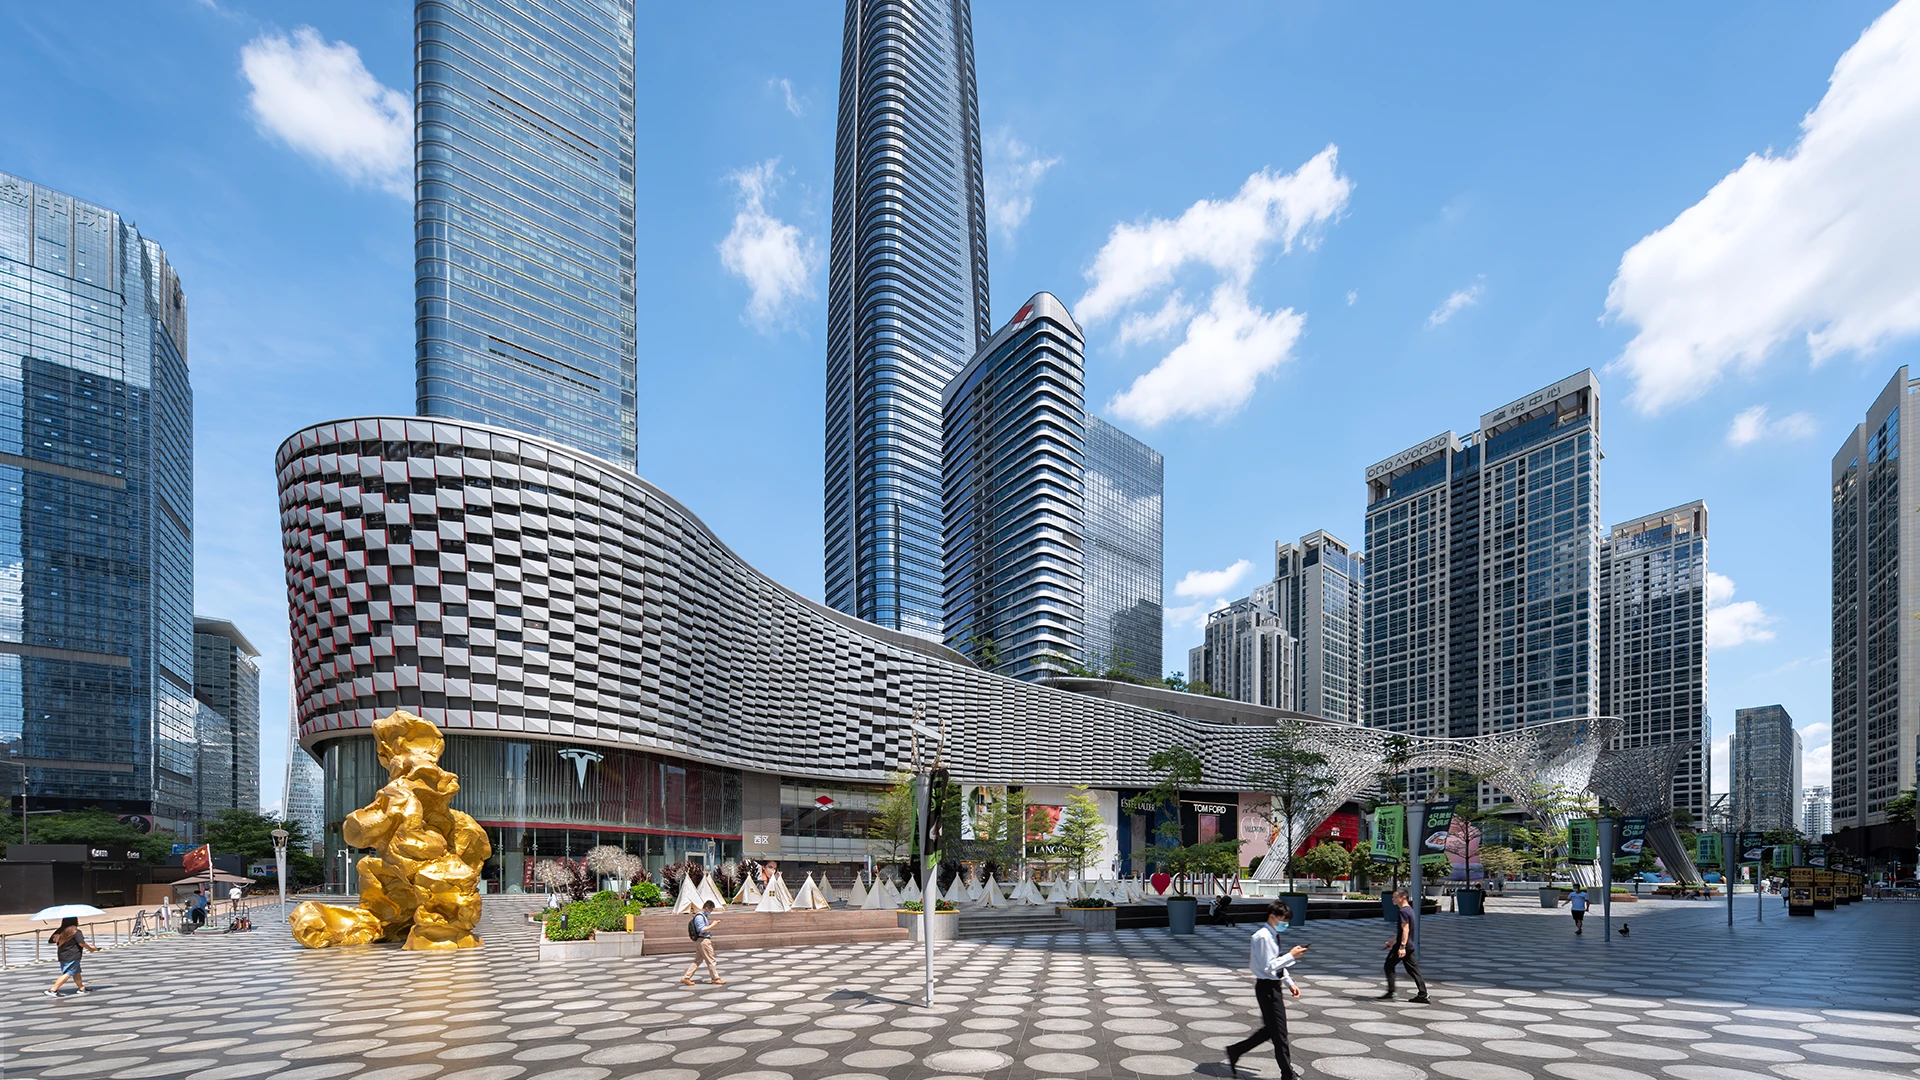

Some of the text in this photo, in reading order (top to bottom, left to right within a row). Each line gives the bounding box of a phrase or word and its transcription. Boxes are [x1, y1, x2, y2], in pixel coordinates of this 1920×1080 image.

[1193, 803, 1226, 814] TOM FORD
[753, 834, 770, 845] 西区
[1171, 872, 1243, 896] CHINA
